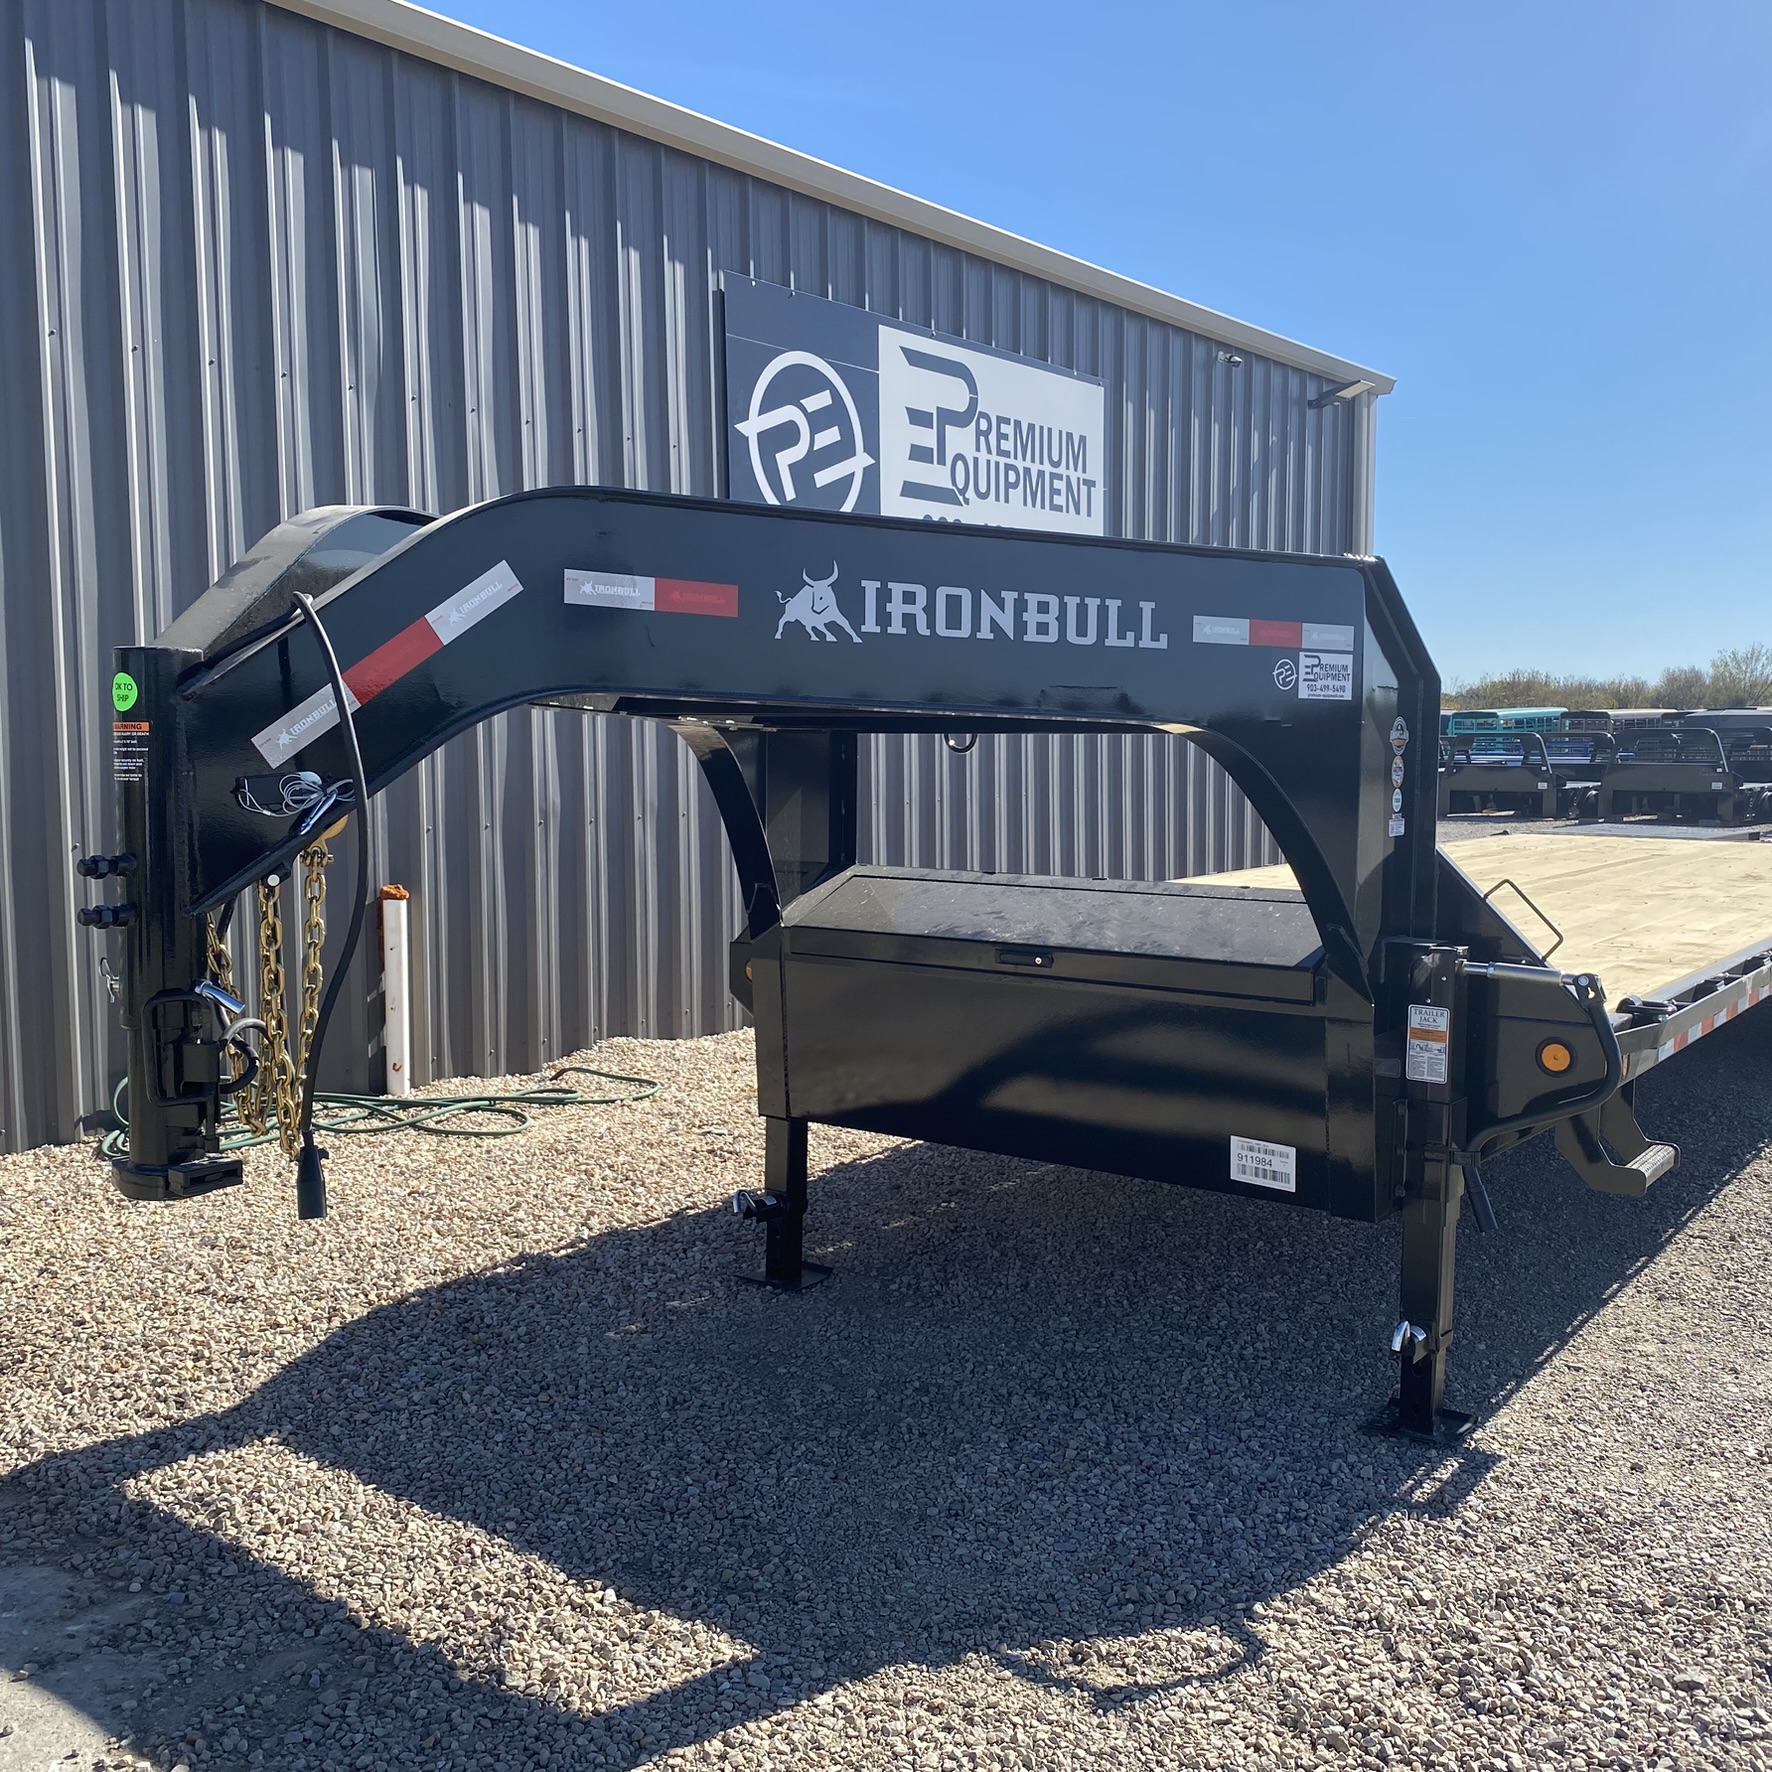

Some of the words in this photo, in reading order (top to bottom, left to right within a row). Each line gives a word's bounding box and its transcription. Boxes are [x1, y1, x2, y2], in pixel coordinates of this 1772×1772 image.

[594, 584, 641, 597] IRONBULL
[458, 581, 504, 615] IRONBULL
[860, 579, 1168, 649] IRONBULL
[123, 682, 133, 691] TO
[289, 698, 338, 736] IRONBULL
[1413, 1008, 1446, 1018] TRAILER
[1419, 1015, 1438, 1024] JACK
[1236, 1152, 1273, 1168] 911984
